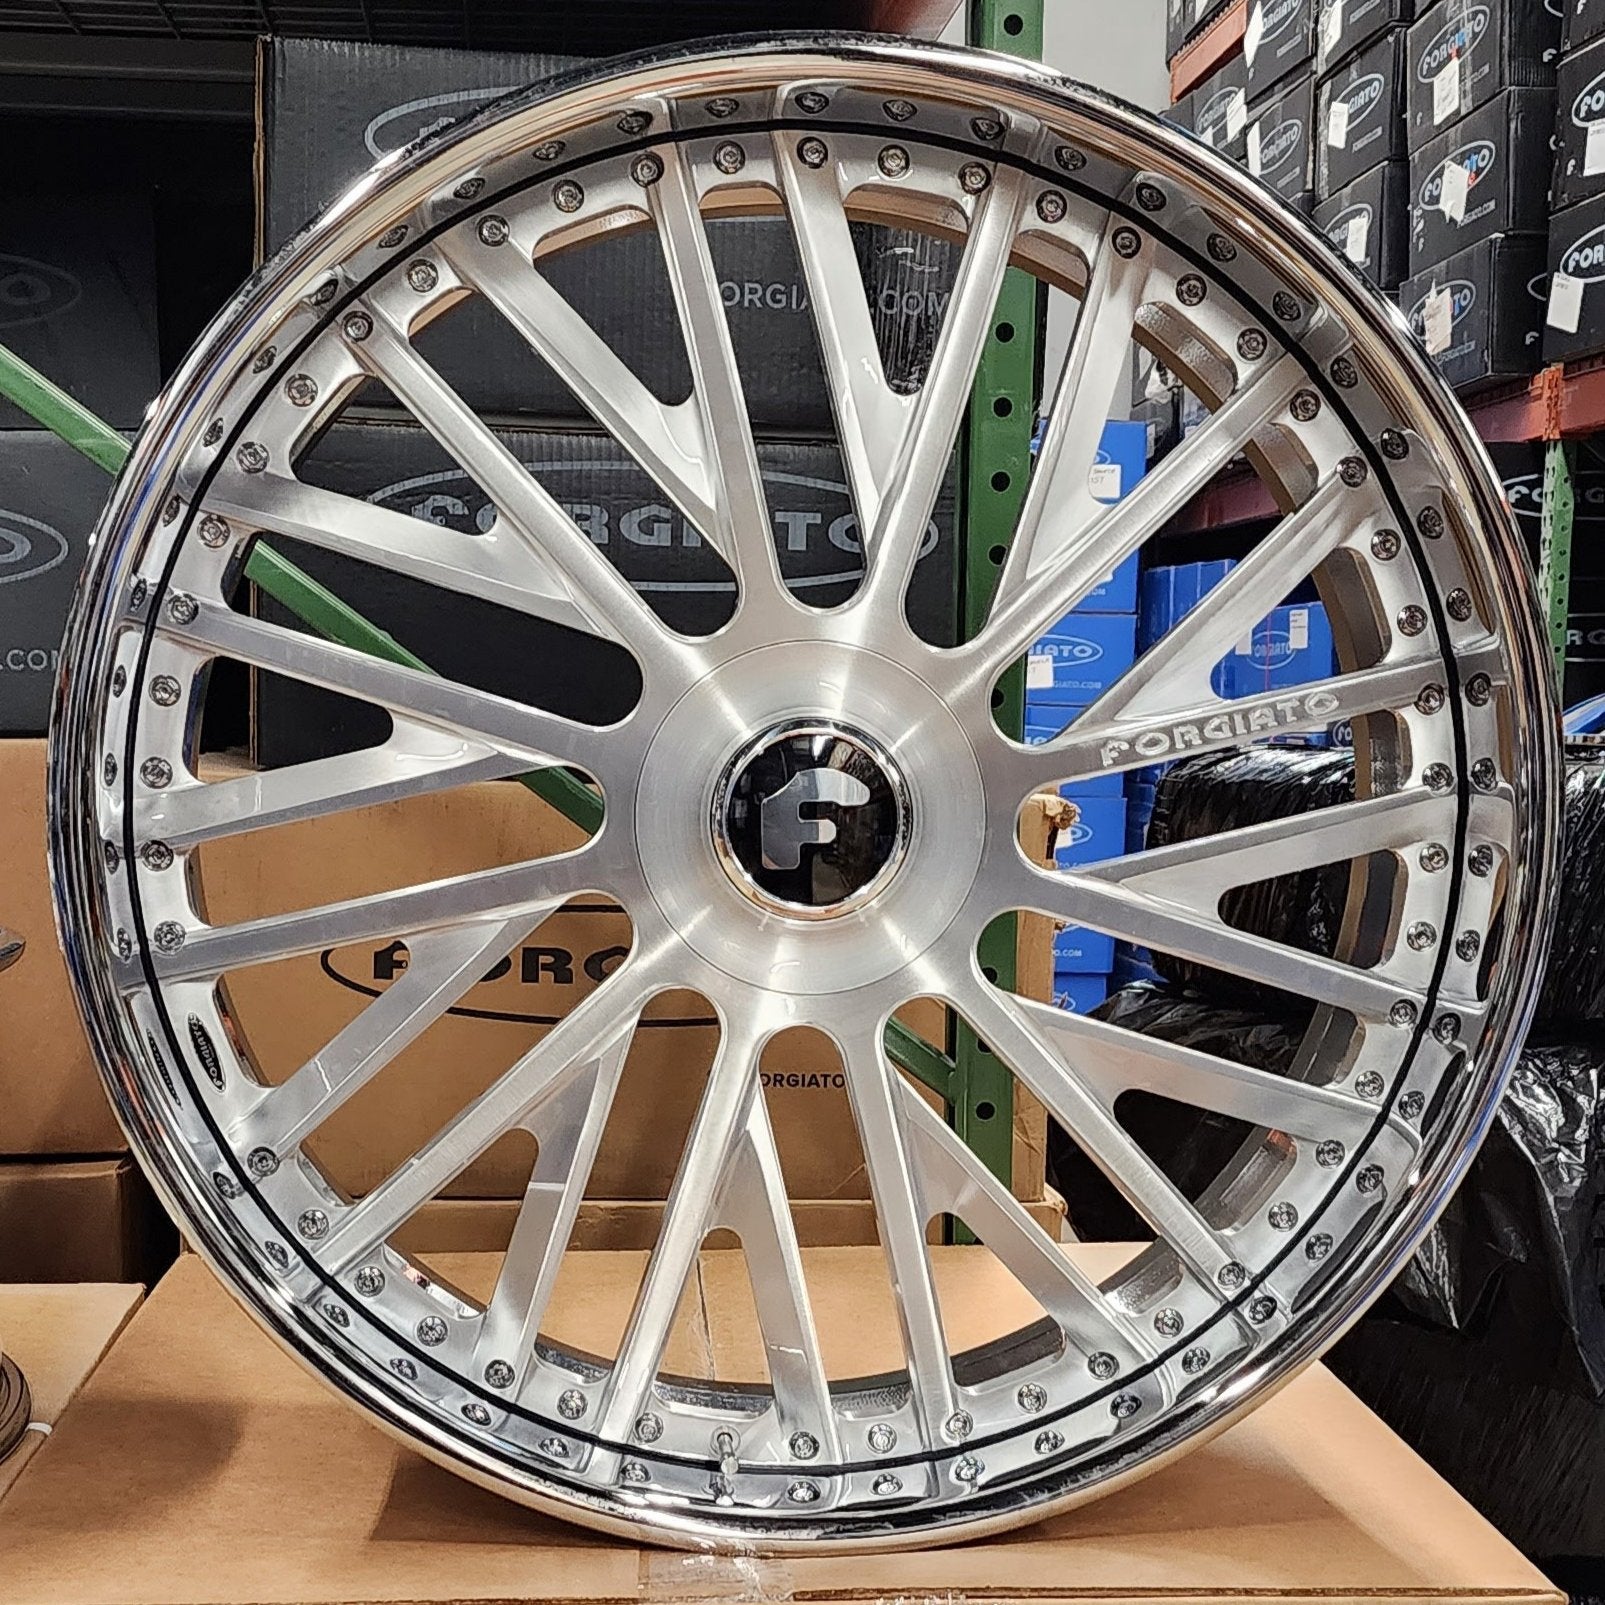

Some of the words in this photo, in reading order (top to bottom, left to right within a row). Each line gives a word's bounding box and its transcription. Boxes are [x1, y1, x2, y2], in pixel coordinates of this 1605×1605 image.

[1349, 80, 1380, 114] GIATO
[1101, 692, 1340, 767] FORGIATO
[760, 1073, 845, 1088] ORGIATO
